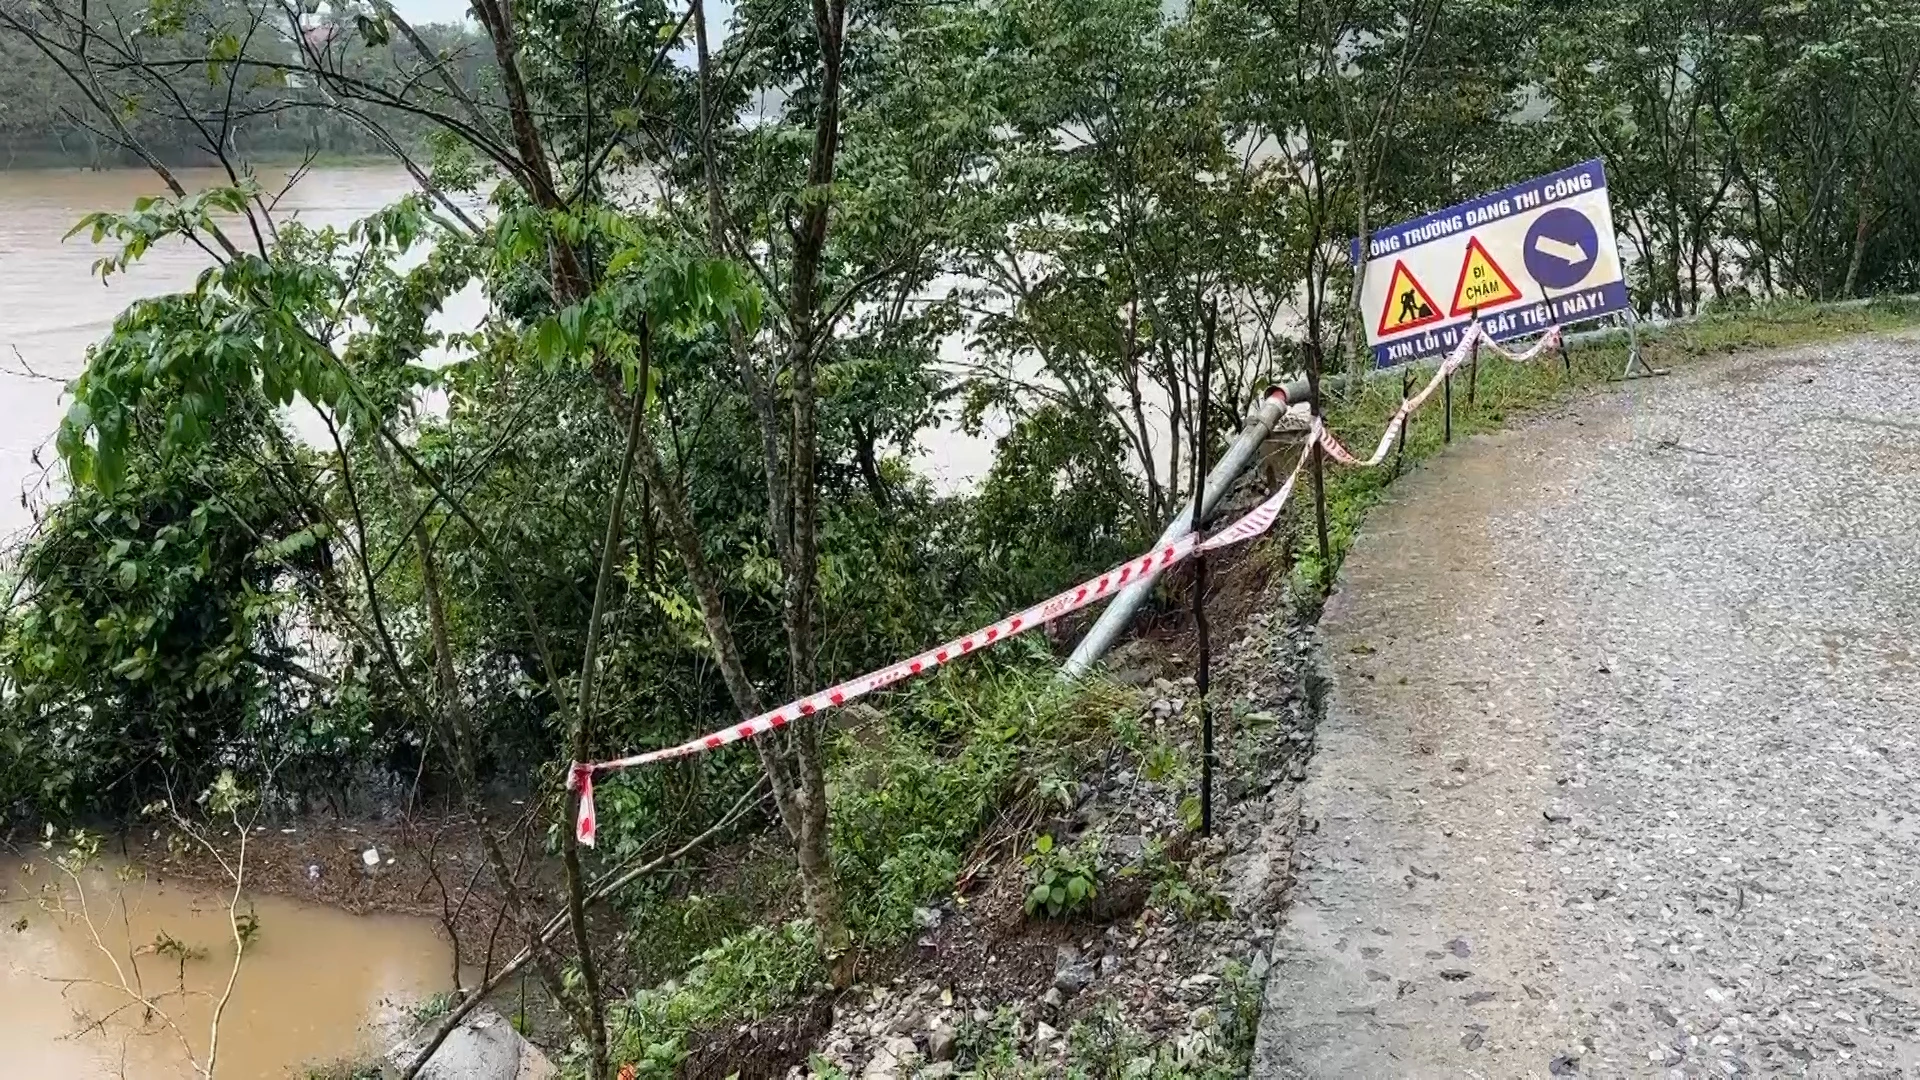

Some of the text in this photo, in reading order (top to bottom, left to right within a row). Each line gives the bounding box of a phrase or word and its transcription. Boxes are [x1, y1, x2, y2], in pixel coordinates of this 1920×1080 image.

[1367, 173, 1592, 258] ÔNG TRƯỜNG ĐANG THI CÔNG
[1466, 279, 1499, 300] CHẬM
[1473, 265, 1485, 279] ĐI
[1387, 341, 1413, 360] XIN
[1443, 327, 1459, 346] VÌ
[1486, 310, 1517, 335] BẤT
[1562, 291, 1605, 316] NÀY!
